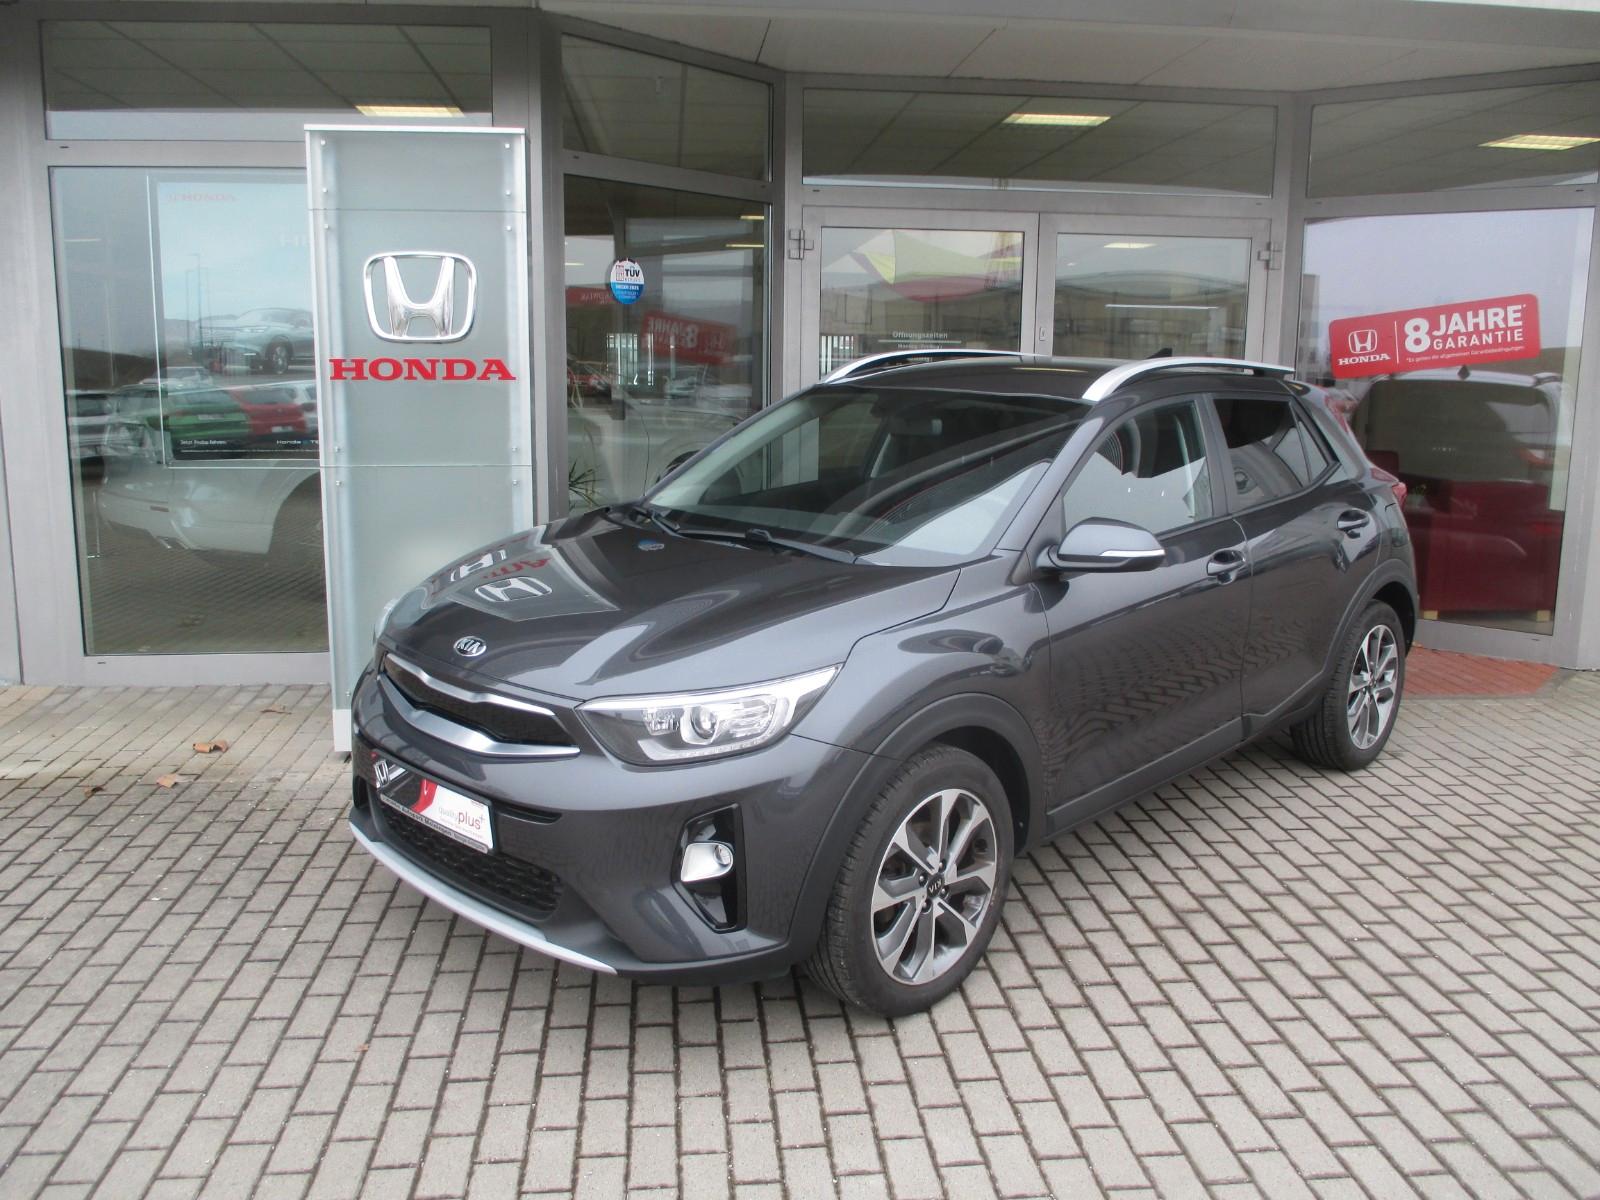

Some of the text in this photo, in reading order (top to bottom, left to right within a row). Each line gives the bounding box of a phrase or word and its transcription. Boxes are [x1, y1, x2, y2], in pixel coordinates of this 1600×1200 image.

[625, 268, 640, 277] TÜV
[1404, 318, 1431, 353] 8
[1433, 328, 1524, 350] GARANTIE
[329, 358, 516, 381] HONDA
[1338, 353, 1391, 366] HONDA
